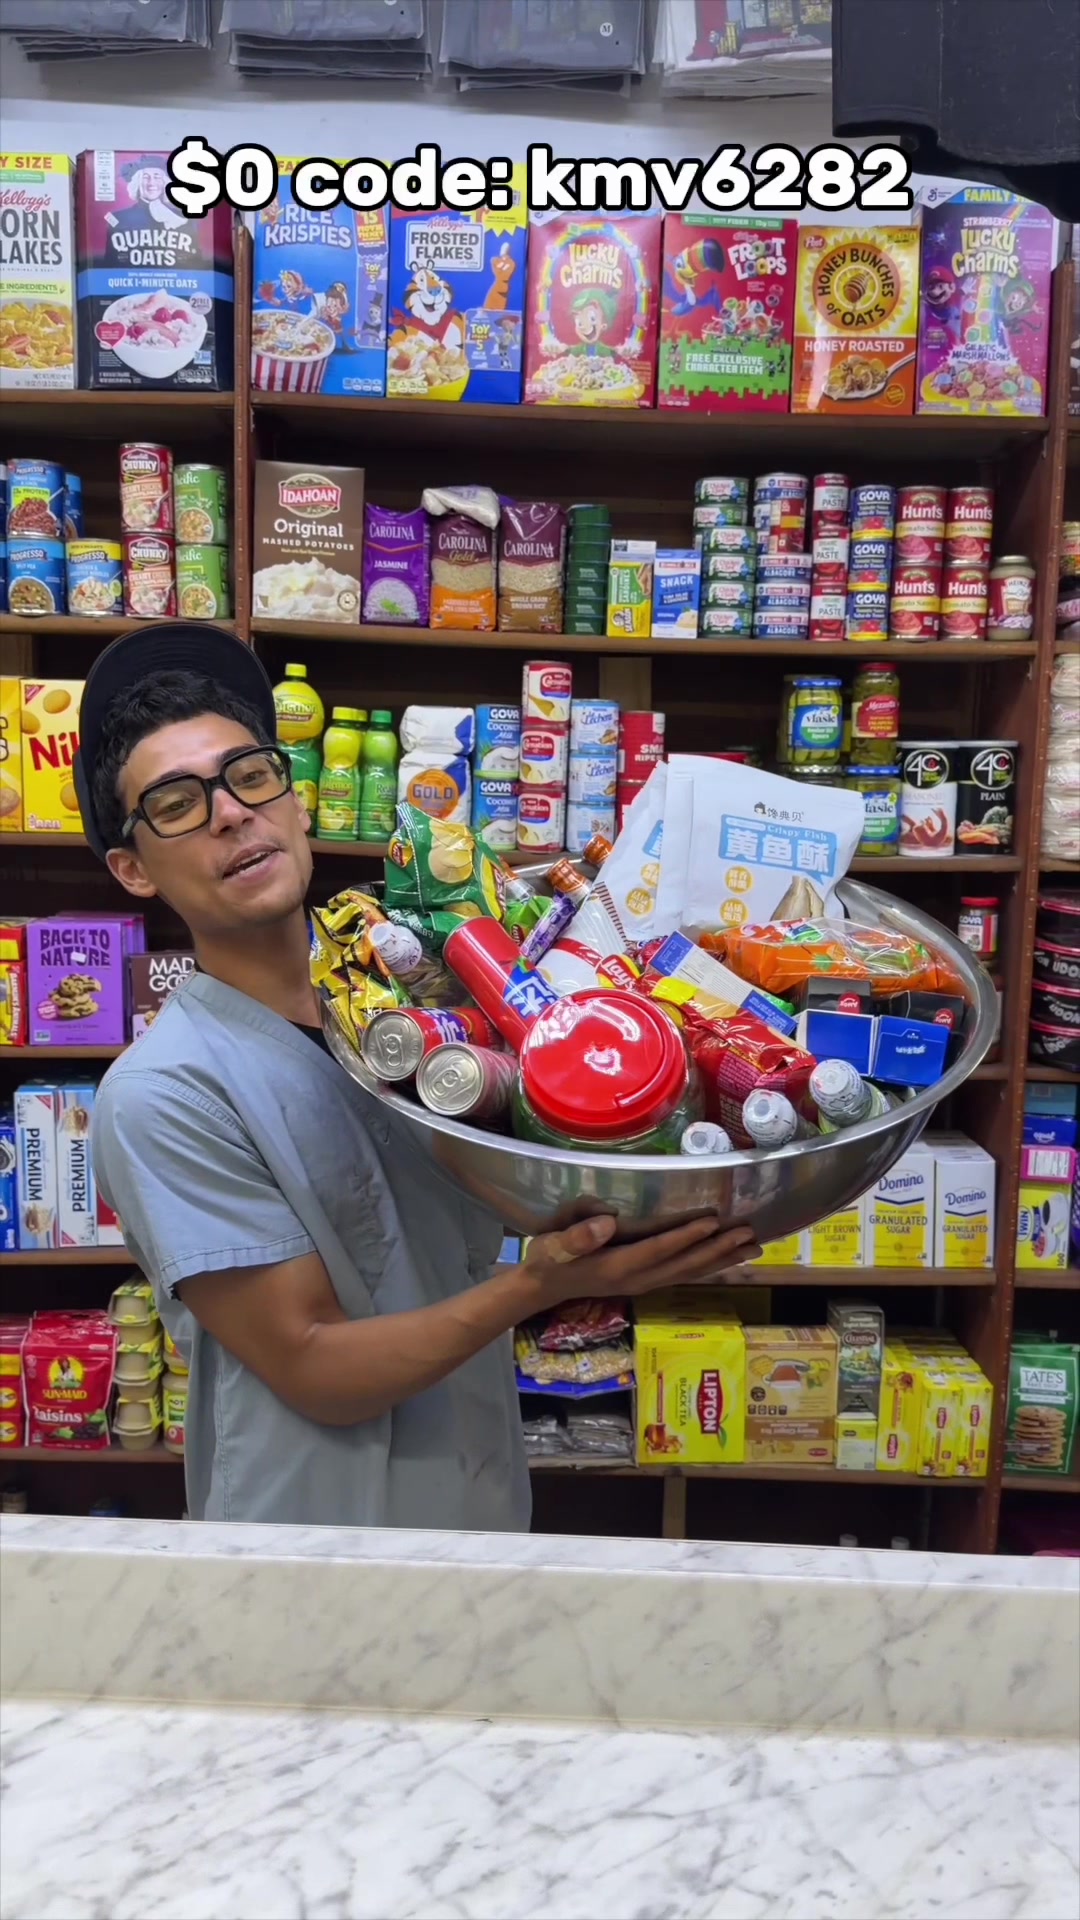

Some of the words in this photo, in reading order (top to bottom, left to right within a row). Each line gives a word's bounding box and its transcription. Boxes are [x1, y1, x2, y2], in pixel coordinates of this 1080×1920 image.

[15, 156, 53, 169] SIZE
[964, 188, 1011, 202] FAMILY
[285, 204, 333, 226] RICE
[963, 216, 1013, 228] STRAWBERRY
[1, 209, 60, 239] ORN
[427, 216, 465, 230] Kellogg's
[110, 229, 193, 253] QUAKER
[263, 223, 353, 249] KRISPIES
[410, 231, 480, 246] FROSTED
[805, 237, 825, 249] Post
[960, 228, 1017, 252] Lucky
[0, 240, 63, 266] LAKES
[130, 250, 176, 267] OATS
[415, 246, 473, 260] FLAKES
[568, 243, 621, 267] Lucky
[728, 237, 786, 267] FROOT
[365, 263, 381, 274] TOY
[734, 257, 787, 281] LOOPS
[951, 250, 1020, 277] Charms
[560, 264, 623, 289] Charms
[817, 250, 849, 297] HONEY
[850, 248, 894, 298] BUNCHES
[6, 283, 58, 291] INGREDIENTS
[108, 278, 134, 288] QUICK
[135, 278, 174, 288] 1-MINUTE
[175, 279, 198, 289] OATS
[841, 303, 886, 327] OATS
[470, 323, 490, 335] TOY
[804, 340, 847, 352] HONEY
[849, 340, 905, 352] ROASTED
[965, 343, 996, 352] GALACTIC
[686, 353, 711, 364] FREE
[712, 354, 764, 366] EXCLUSIVE
[951, 350, 1012, 361] MARSHMALLOWS
[685, 363, 735, 375] CHARACTER
[736, 364, 764, 375] ITEM
[16, 465, 44, 475] PROGRESSO
[122, 461, 158, 472] CHUNKY
[177, 471, 200, 485] cific
[282, 488, 338, 503] IDAHOAN
[859, 490, 890, 501] GOYA
[822, 498, 846, 508] PASTE
[902, 506, 943, 519] Hunt's
[954, 506, 992, 520] Hunt's
[273, 518, 344, 539] Original
[369, 522, 416, 541] CAROLINA
[262, 537, 302, 547] MASHED
[304, 540, 355, 551] POTATOES
[438, 533, 488, 552] CAROLINA
[504, 540, 554, 558] CAROLINA
[854, 544, 885, 554] GOYA
[10, 549, 44, 561] PROGRESSO
[70, 550, 106, 562] PROGRESSO
[131, 549, 167, 560] CHUNKY
[178, 547, 203, 561] cific
[449, 550, 475, 563] Gold
[816, 551, 839, 559] PASTE
[374, 560, 409, 570] JASMINE
[764, 568, 796, 577] ALBACORE
[660, 575, 694, 588] SNACK
[895, 581, 935, 594] Hunt's
[948, 582, 987, 595] Hunt's
[1008, 579, 1028, 587] HEINZ
[767, 598, 800, 606] ALBACORE
[855, 593, 886, 604] GOYA
[818, 607, 841, 616] PASTE
[766, 626, 799, 635] ALBACORE
[490, 708, 520, 720] GOYA
[906, 753, 941, 787] 4C
[975, 753, 1009, 786] 4C
[412, 783, 454, 800] GOLD
[480, 781, 512, 793] GOYA
[980, 792, 1005, 801] PLAIN
[864, 802, 893, 814] lasic
[767, 824, 799, 838] Crispy
[804, 829, 827, 841] Fish
[727, 828, 829, 873] 黄鱼酥
[40, 929, 86, 950] BACK
[88, 929, 110, 950] TO
[40, 948, 111, 967] NATURE
[149, 957, 195, 974] MAD
[603, 958, 636, 992] Lay's
[149, 975, 189, 992] GOO
[26, 1128, 43, 1201] PREMIUM
[70, 1139, 86, 1212] PREMIUM
[879, 1172, 924, 1191] Domino
[945, 1190, 987, 1205] Domino
[869, 1214, 928, 1226] GRANULATED
[1018, 1211, 1029, 1237] TWIN
[808, 1225, 831, 1234] LIGHT
[833, 1224, 862, 1234] BROWN
[886, 1225, 911, 1234] SUGAR
[942, 1224, 988, 1233] GRANULATED
[955, 1232, 976, 1240] SUGAR
[1057, 1253, 1065, 1266] 100
[844, 1333, 877, 1344] CELESTIAL
[1023, 1370, 1065, 1384] TATE'S
[679, 1378, 687, 1407] BLACK
[703, 1371, 717, 1433] LIPTON
[32, 1405, 83, 1423] Raisins
[679, 1409, 687, 1427] TEA
